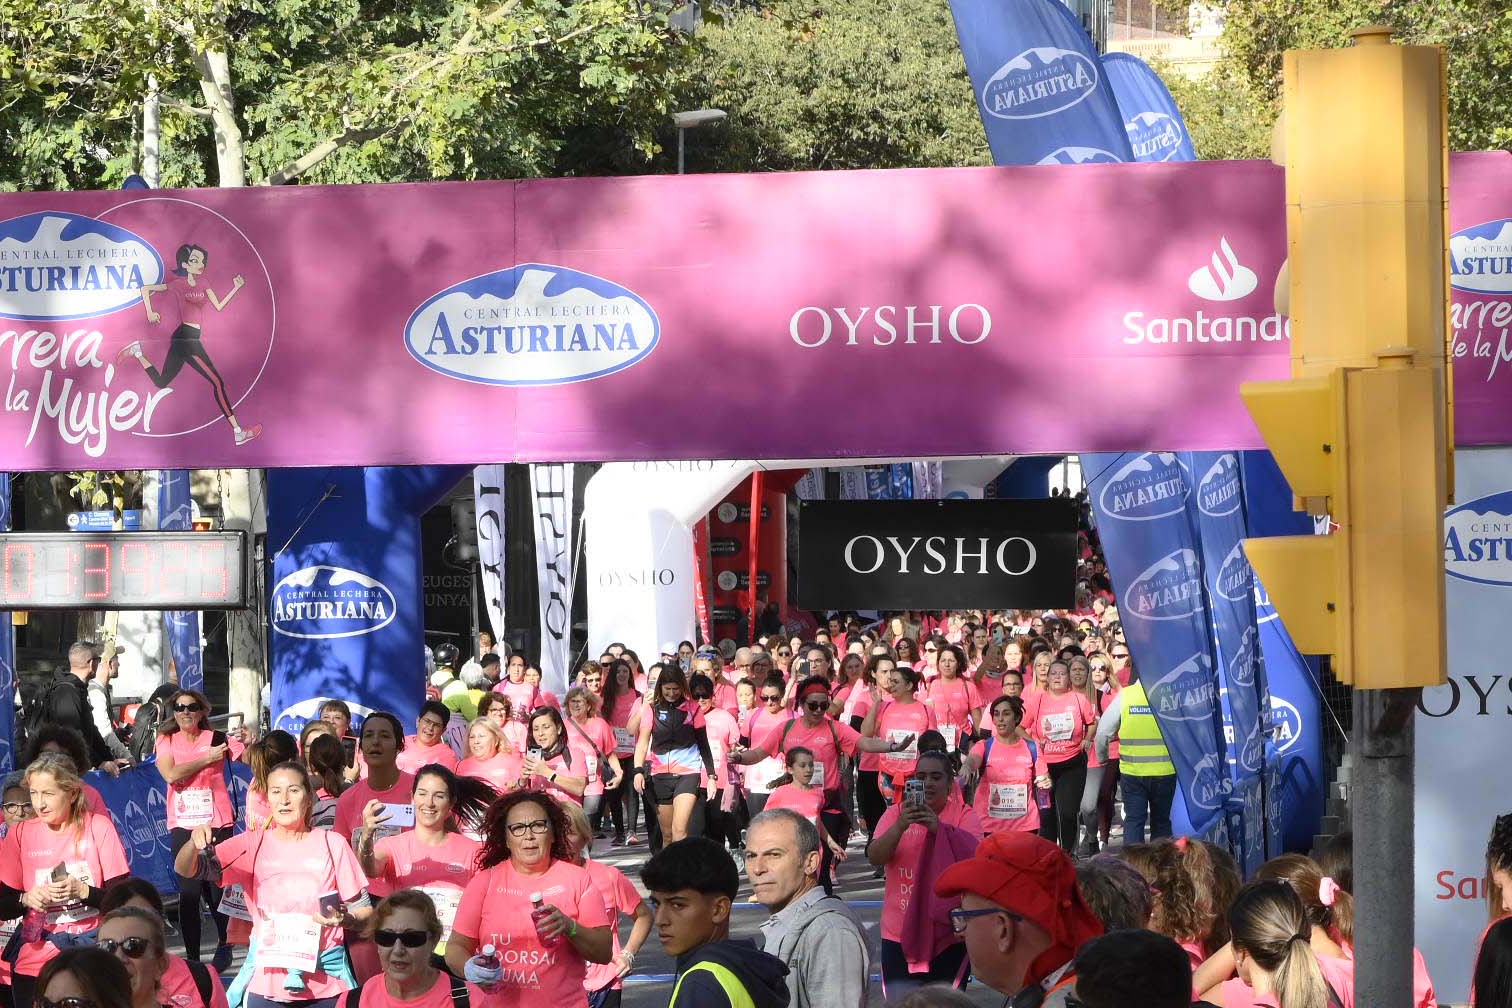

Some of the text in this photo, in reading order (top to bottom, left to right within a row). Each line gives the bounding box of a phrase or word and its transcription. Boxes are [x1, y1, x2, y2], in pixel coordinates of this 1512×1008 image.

[67, 247, 140, 260] LECHERA
[463, 304, 631, 320] CENTRAL LECHERA
[424, 311, 640, 357] ASTURIANA
[789, 303, 993, 349] OYSHO
[1474, 330, 1491, 358] la
[6, 371, 30, 413] la
[25, 363, 173, 458] Mujer
[844, 535, 1037, 576] OYSHO
[286, 588, 383, 599] CENTRAL LECHERA
[274, 594, 387, 623] ASTURIANA
[899, 867, 913, 880] TU
[491, 933, 511, 946] TU
[502, 968, 539, 985] UMA
